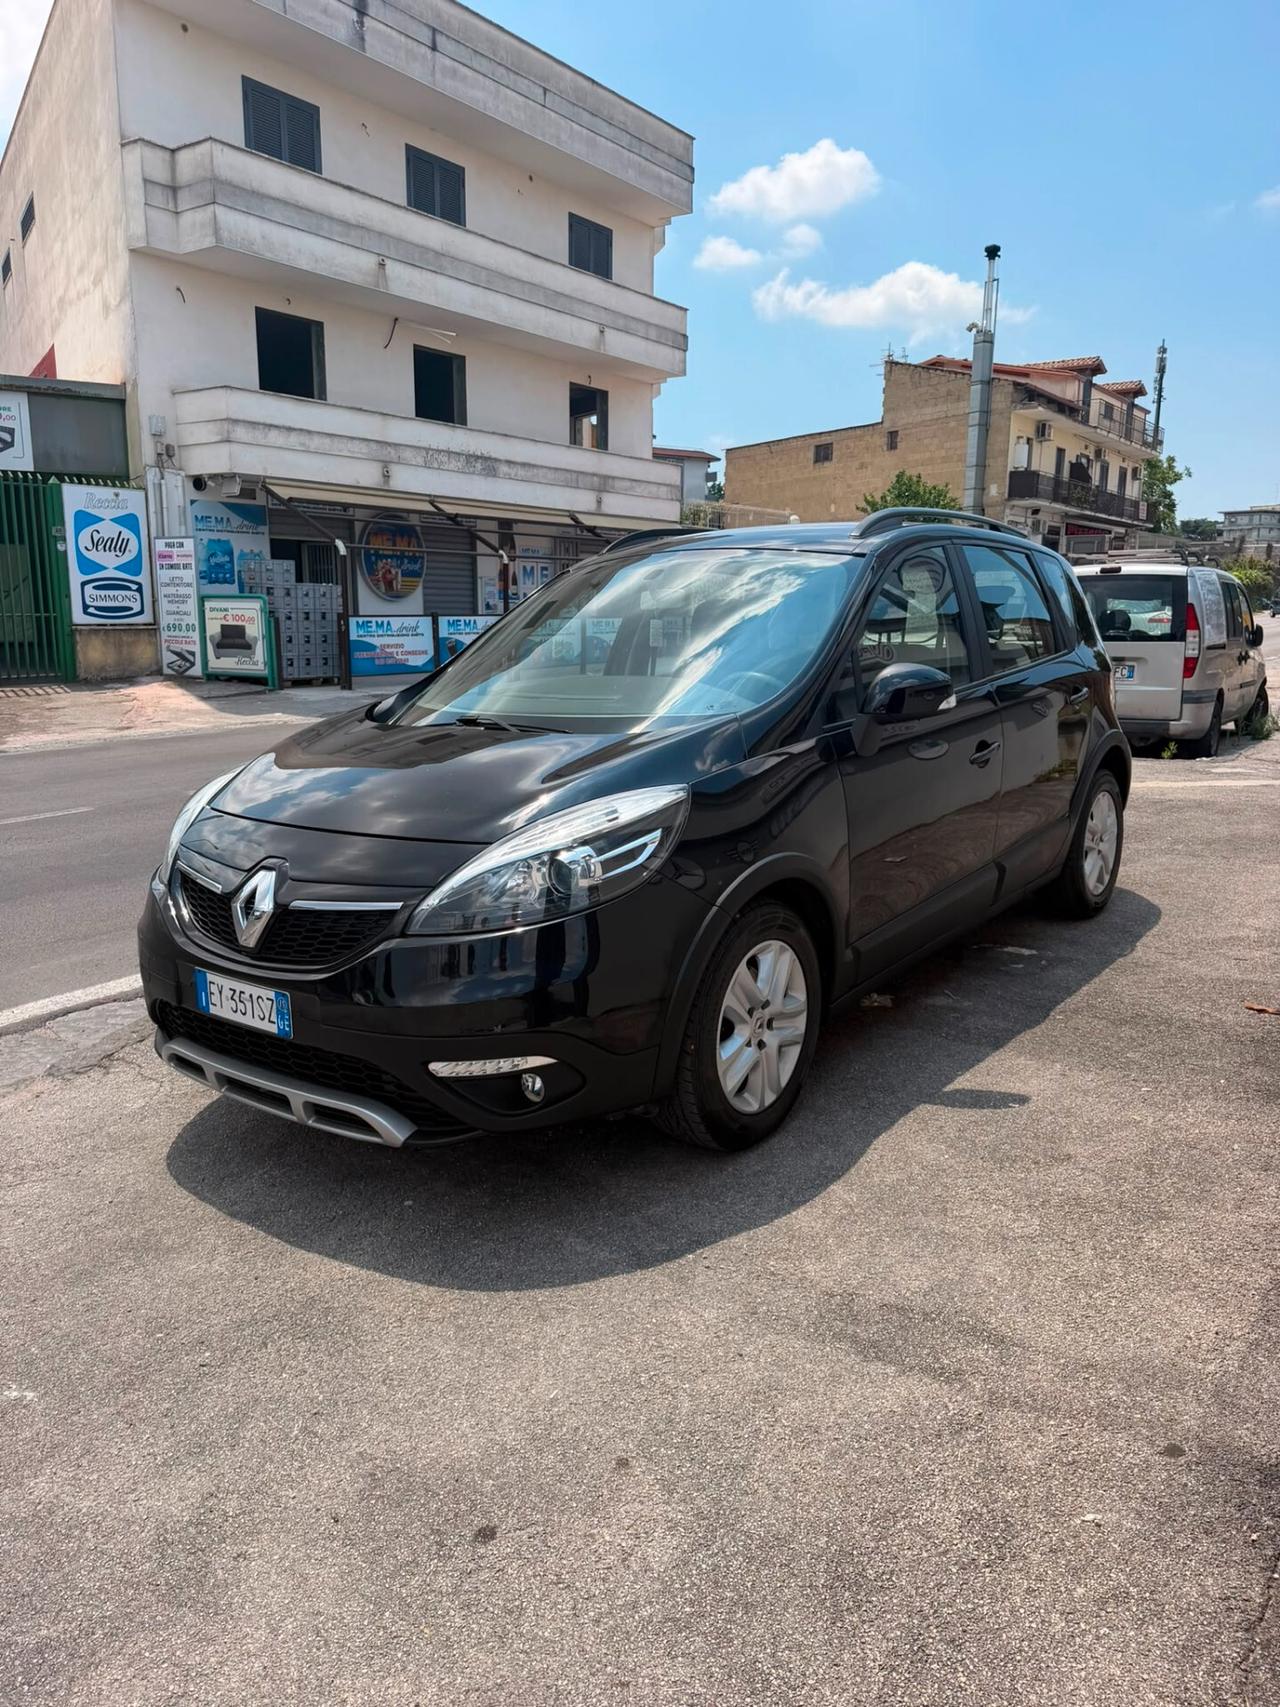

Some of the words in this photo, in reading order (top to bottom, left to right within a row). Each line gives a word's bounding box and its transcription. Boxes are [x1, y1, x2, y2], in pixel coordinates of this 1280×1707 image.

[84, 528, 130, 558] Sealy
[88, 593, 138, 604] SIMMONS
[355, 619, 393, 633] ME.MA
[208, 981, 224, 1009] EY
[228, 987, 276, 1025] 351SZ
